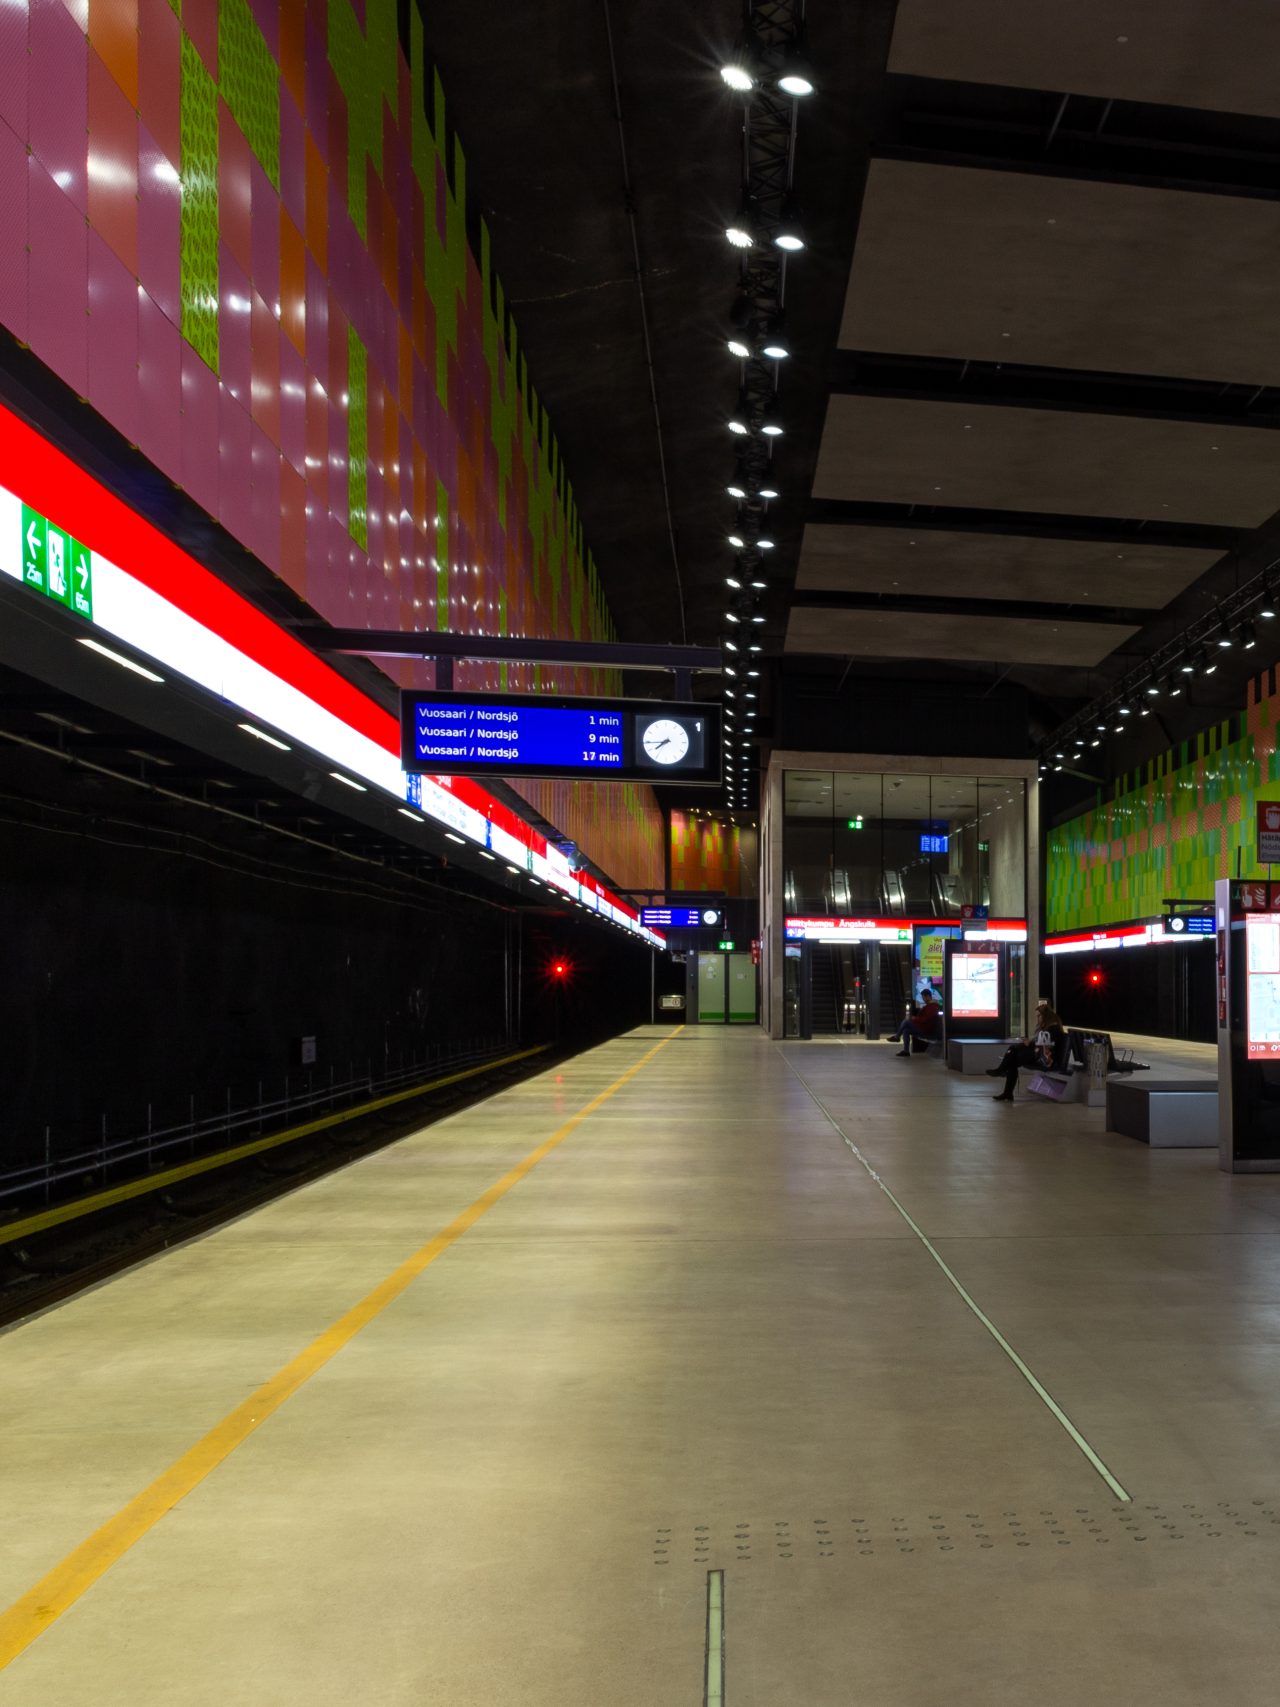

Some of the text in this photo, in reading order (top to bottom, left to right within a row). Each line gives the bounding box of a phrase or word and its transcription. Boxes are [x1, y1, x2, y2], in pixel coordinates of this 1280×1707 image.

[419, 708, 519, 723] Vuosaari / Nordsjö
[589, 715, 619, 726] 1 min
[695, 722, 701, 732] 1
[419, 726, 519, 741] Vuosaari / Nordsjö
[588, 733, 619, 744] 9 min
[419, 745, 519, 760] Vuosaari / Nordsjö
[582, 751, 619, 762] 17 min
